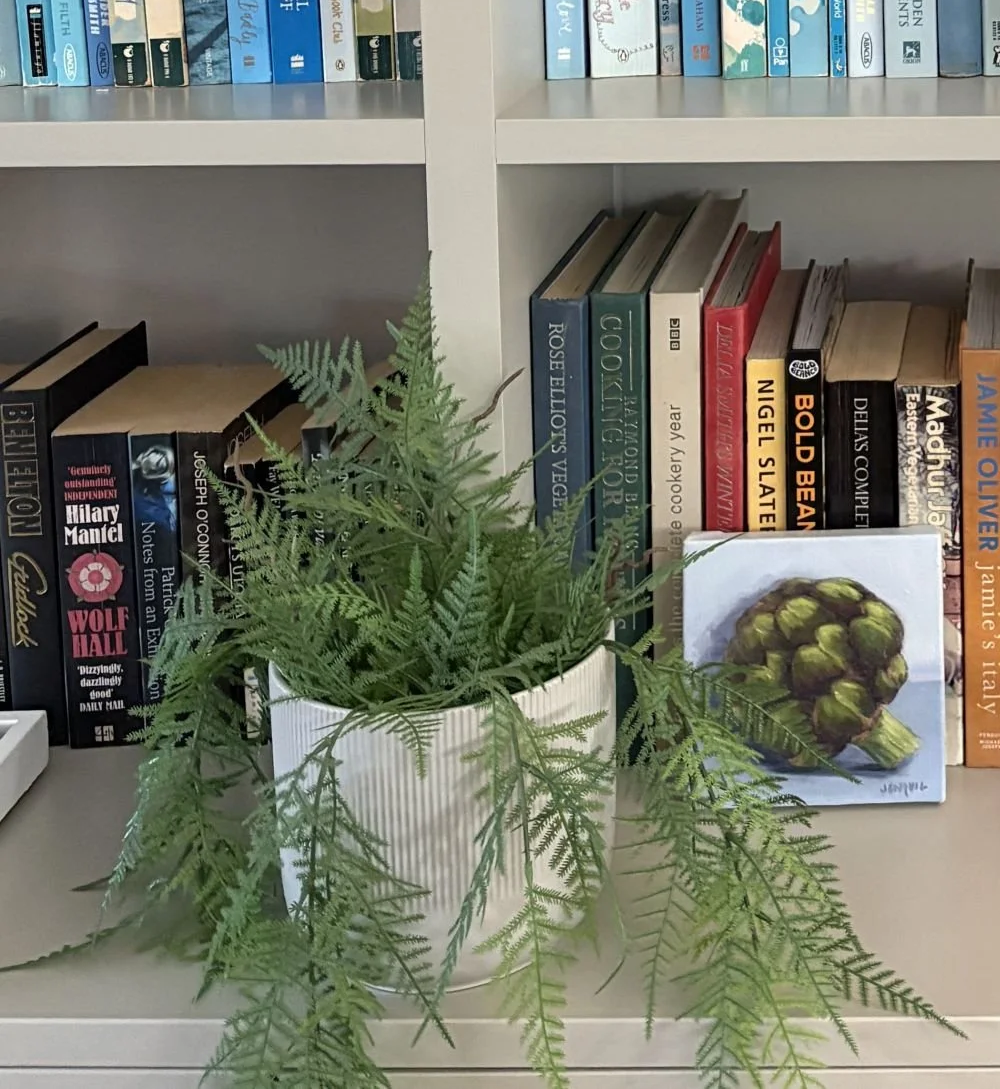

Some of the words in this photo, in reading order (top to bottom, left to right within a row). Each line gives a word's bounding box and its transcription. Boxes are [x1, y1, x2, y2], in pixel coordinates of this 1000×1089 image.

[59, 2, 71, 36] FILTH
[2, 404, 35, 454] BEN
[758, 380, 775, 446] NIGEL
[795, 395, 814, 463] BOLD
[854, 398, 868, 451] DELIA'S
[976, 372, 998, 448] JAMIE
[5, 460, 42, 537] ELTON
[64, 505, 121, 525] Hilary
[977, 458, 999, 551] OLIVER
[63, 525, 124, 545] Mantel
